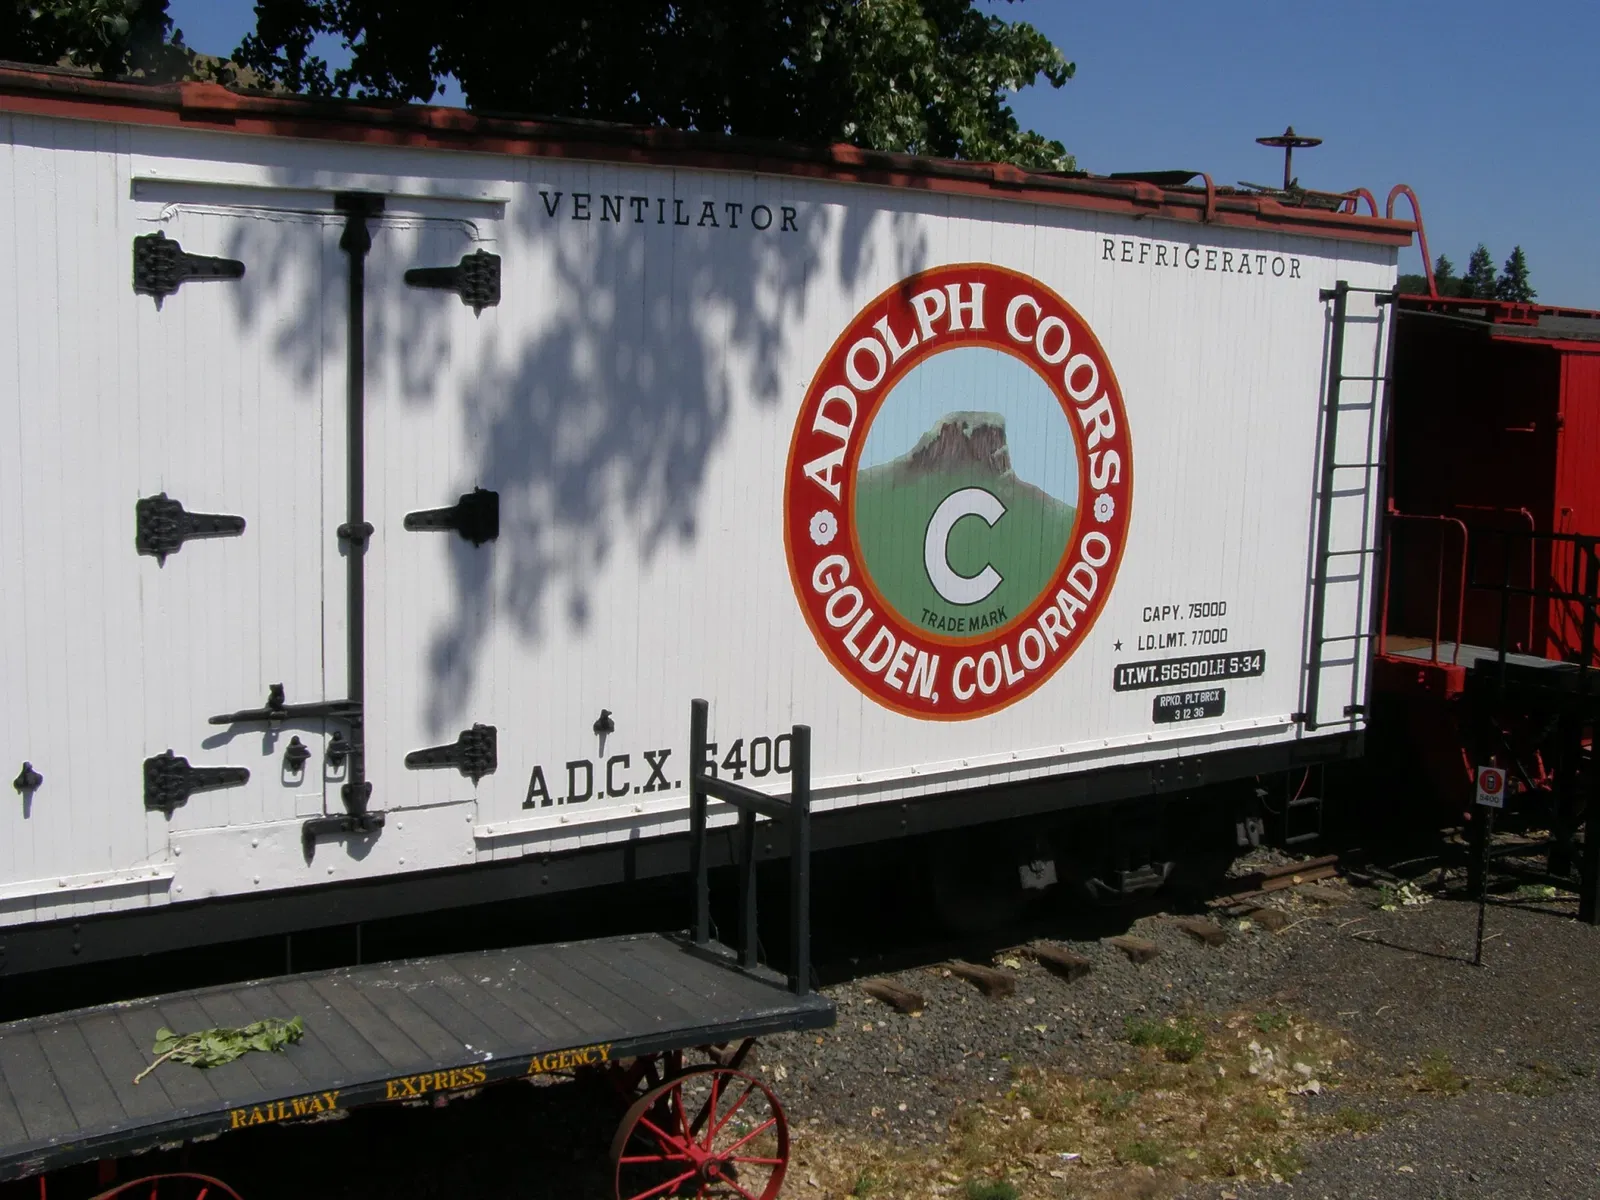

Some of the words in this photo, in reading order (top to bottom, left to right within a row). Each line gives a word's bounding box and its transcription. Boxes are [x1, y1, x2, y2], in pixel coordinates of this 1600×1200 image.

[539, 191, 798, 232] VENTILATOR
[1102, 238, 1301, 279] REFRIGERATOR
[802, 282, 986, 501] ADOLPH
[1005, 294, 1120, 491] COORS
[924, 486, 1008, 606] C
[811, 553, 940, 704] GOLDEN,
[952, 531, 1112, 702] COLORADO
[920, 607, 965, 633] TRADE
[968, 605, 1009, 632] MARK
[1142, 604, 1184, 623] CAPY.
[1188, 601, 1227, 619] 75000
[1191, 628, 1228, 646] 77000
[522, 748, 682, 810] A.D.C.X.
[230, 1090, 340, 1129] RAILWAY
[385, 1064, 487, 1100] EXPRESS
[527, 1043, 612, 1074] AGENCY
